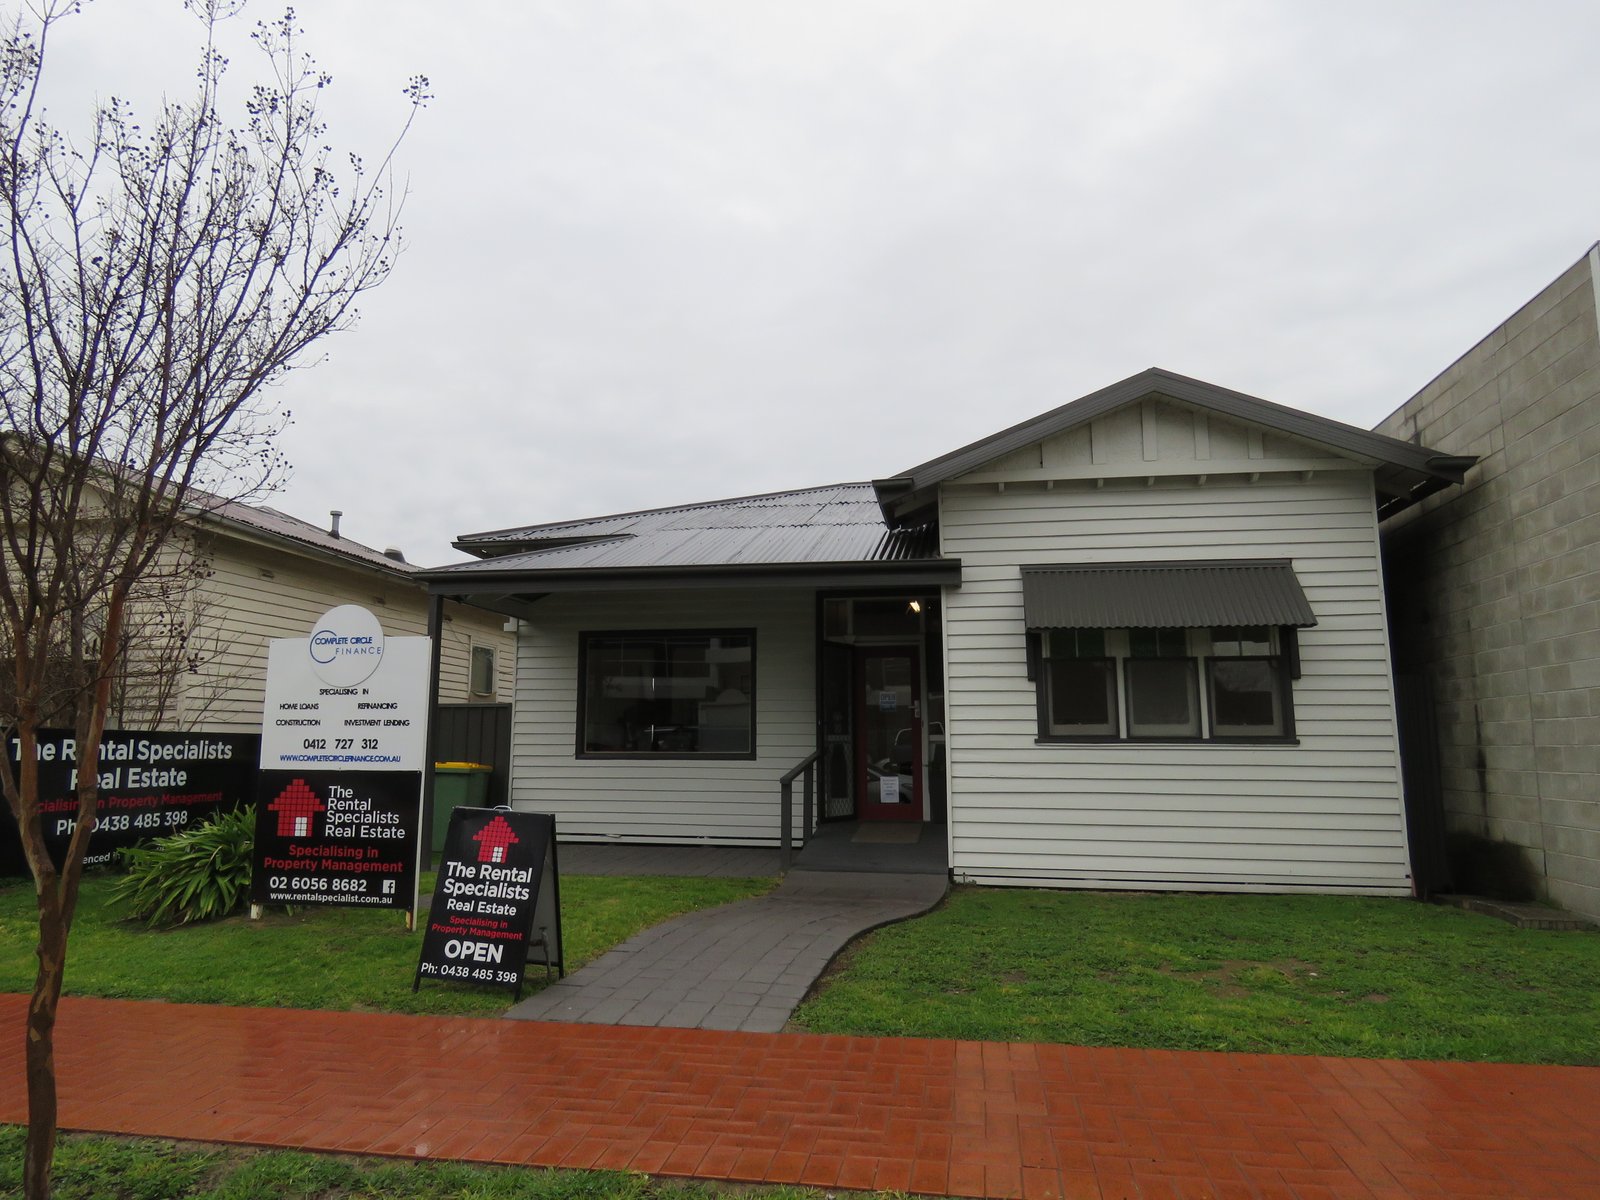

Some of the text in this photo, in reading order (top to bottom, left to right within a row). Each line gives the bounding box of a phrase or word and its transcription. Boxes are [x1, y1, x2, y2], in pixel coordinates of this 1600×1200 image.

[314, 636, 372, 645] COMPLETE CIRCLE
[335, 646, 382, 655] FINANCE
[319, 688, 358, 696] SPECIALISING
[279, 702, 319, 710] HOME LOANS
[357, 702, 398, 710] REFINANCING
[344, 719, 410, 727] INVESTMENT LENDING
[12, 738, 233, 764] Te Rntal Specialists
[303, 738, 378, 750] 0412 727 312
[280, 754, 401, 763] WWW.COMPLETECIRCLEFINANCE.COM.AU
[127, 769, 188, 789] Estate
[328, 785, 354, 798] The
[108, 795, 159, 811] Property
[161, 791, 223, 808] Management
[327, 798, 372, 811] Rental
[134, 813, 161, 831] 485
[164, 810, 188, 827] 398
[326, 811, 400, 825] Specialists
[325, 824, 406, 839] Real Estate
[288, 844, 379, 860] Specialising in
[263, 858, 403, 873] Property Management
[446, 861, 533, 884] The Rental
[269, 876, 288, 889] 02
[291, 877, 328, 890] 6056
[332, 878, 367, 892] 8682
[442, 878, 530, 901] Specialists
[270, 893, 393, 904] www.rentalspecialist.com.au
[446, 898, 517, 916] Real Estate
[449, 915, 508, 929] Specialising in
[431, 923, 523, 941] Property Management
[444, 939, 504, 964] OPEN
[420, 962, 518, 983] Ph: 0438 485 398
